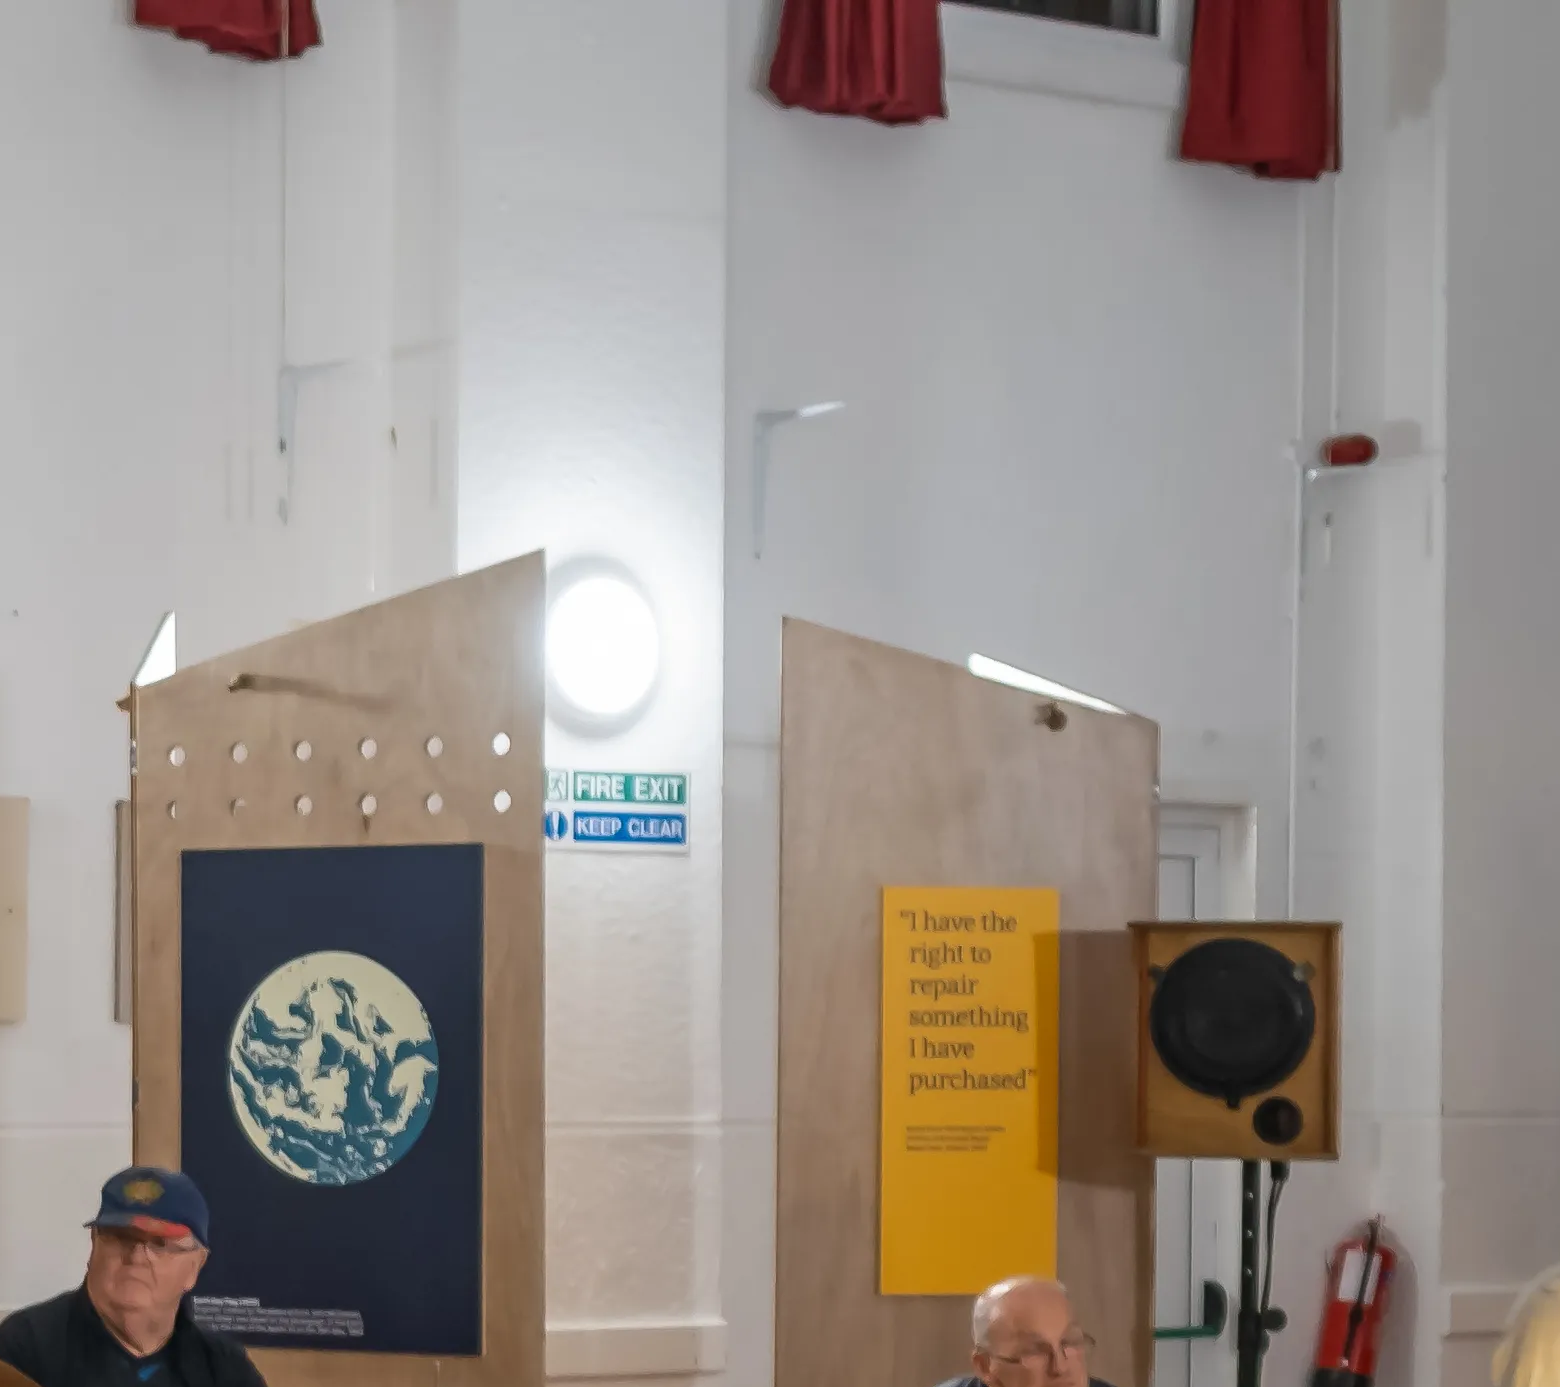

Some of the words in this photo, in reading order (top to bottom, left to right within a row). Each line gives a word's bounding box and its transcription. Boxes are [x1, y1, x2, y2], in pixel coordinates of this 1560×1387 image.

[577, 775, 625, 800] FIRE
[635, 776, 682, 801] EXIT
[577, 817, 622, 836] KEEP
[628, 818, 682, 838] CLEAR
[924, 909, 976, 932] have
[982, 910, 1018, 932] the
[909, 942, 964, 970] right
[971, 945, 992, 964] to
[909, 974, 979, 1001] repair
[909, 1005, 1030, 1033] something
[909, 1038, 916, 1059] I
[924, 1037, 975, 1059] have
